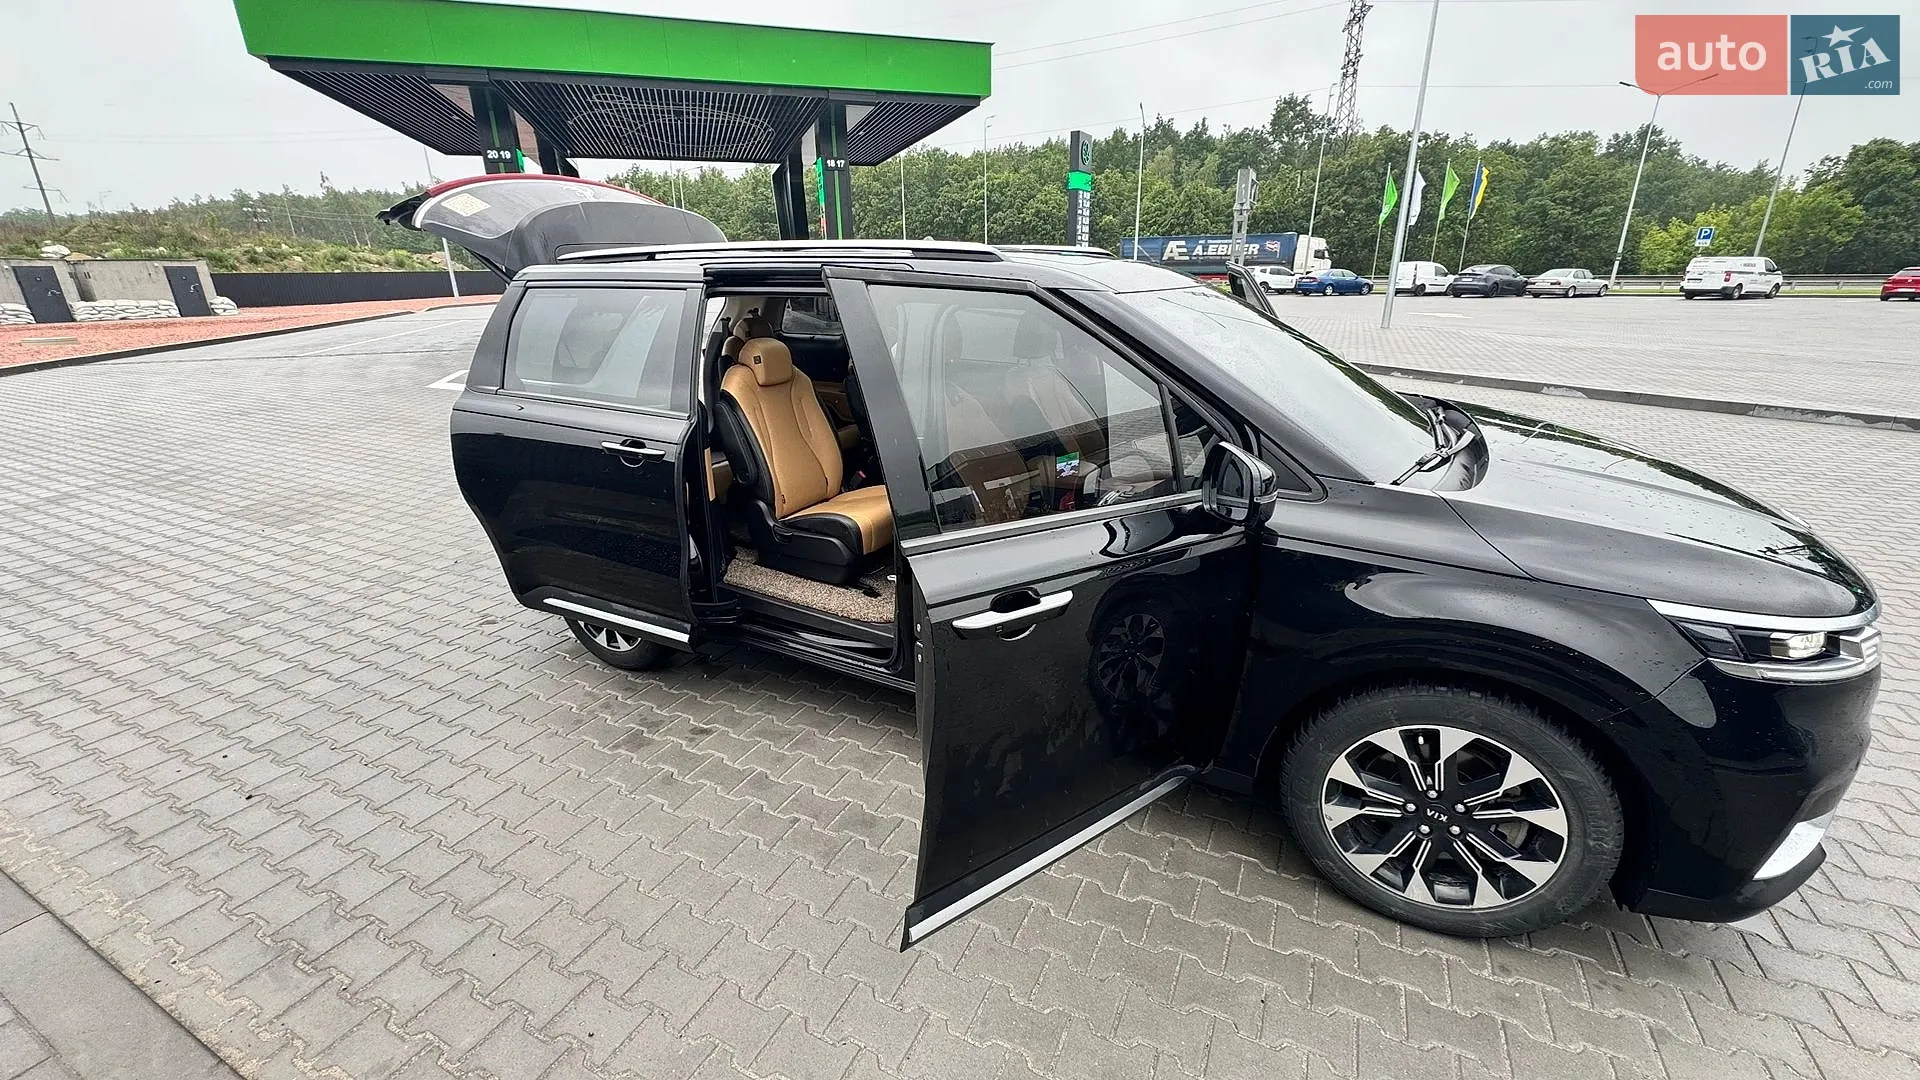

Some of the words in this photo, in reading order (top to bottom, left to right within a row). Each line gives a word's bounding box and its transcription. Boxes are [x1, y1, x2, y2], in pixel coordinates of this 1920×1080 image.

[487, 150, 498, 158] 20
[500, 150, 511, 159] 19
[1701, 229, 1711, 239] P
[1427, 809, 1448, 822] KIA
